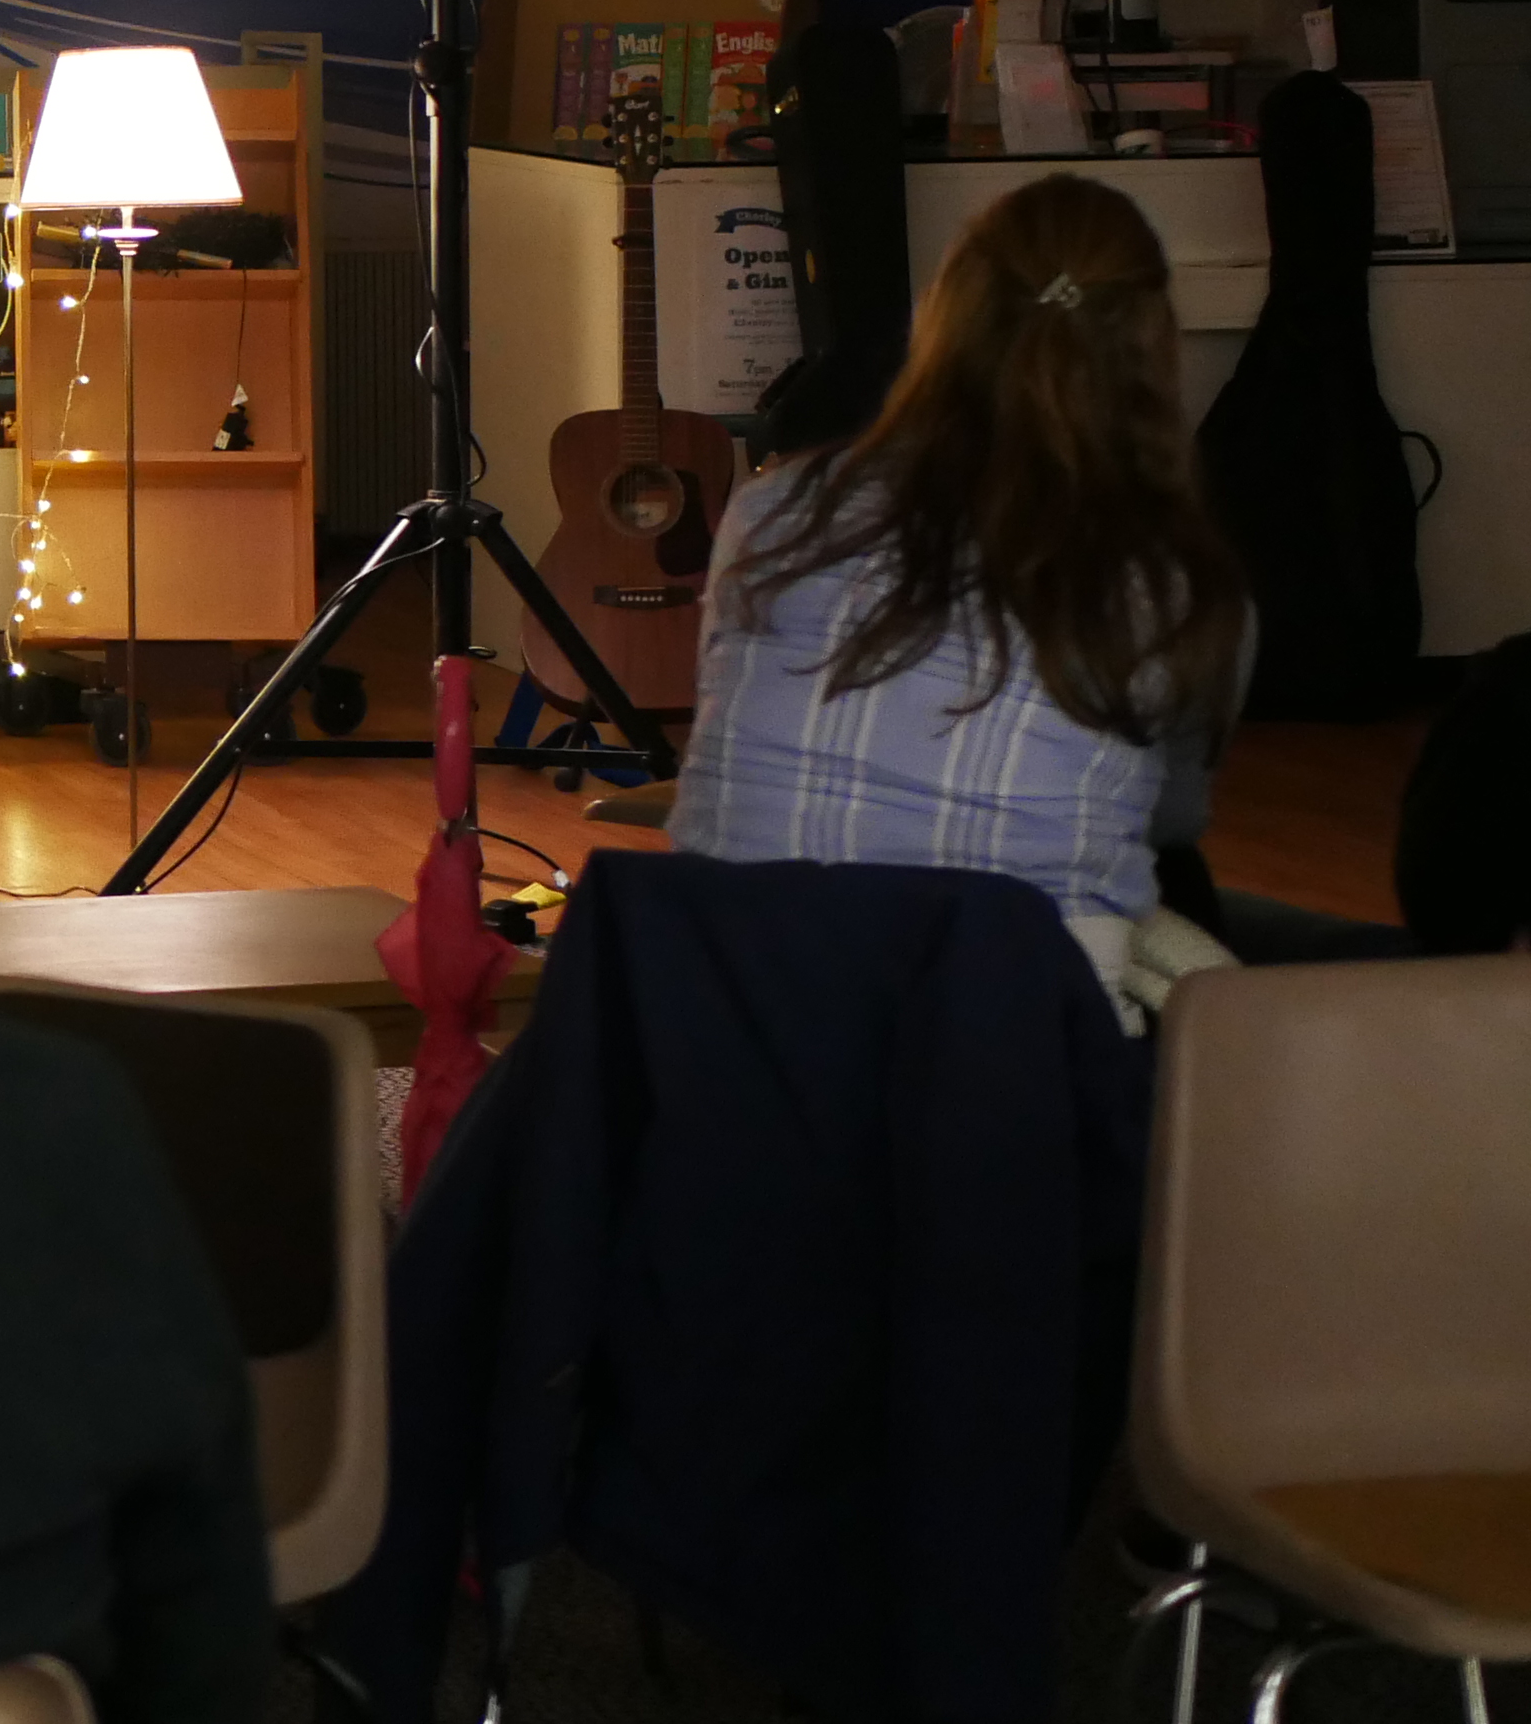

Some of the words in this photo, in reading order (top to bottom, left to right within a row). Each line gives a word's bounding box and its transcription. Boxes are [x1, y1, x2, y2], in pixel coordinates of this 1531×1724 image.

[617, 32, 662, 56] Mat
[715, 31, 776, 55] Englis
[735, 210, 782, 227] Chorley
[724, 247, 790, 269] Open
[726, 278, 739, 290] &
[745, 273, 788, 289] Gin
